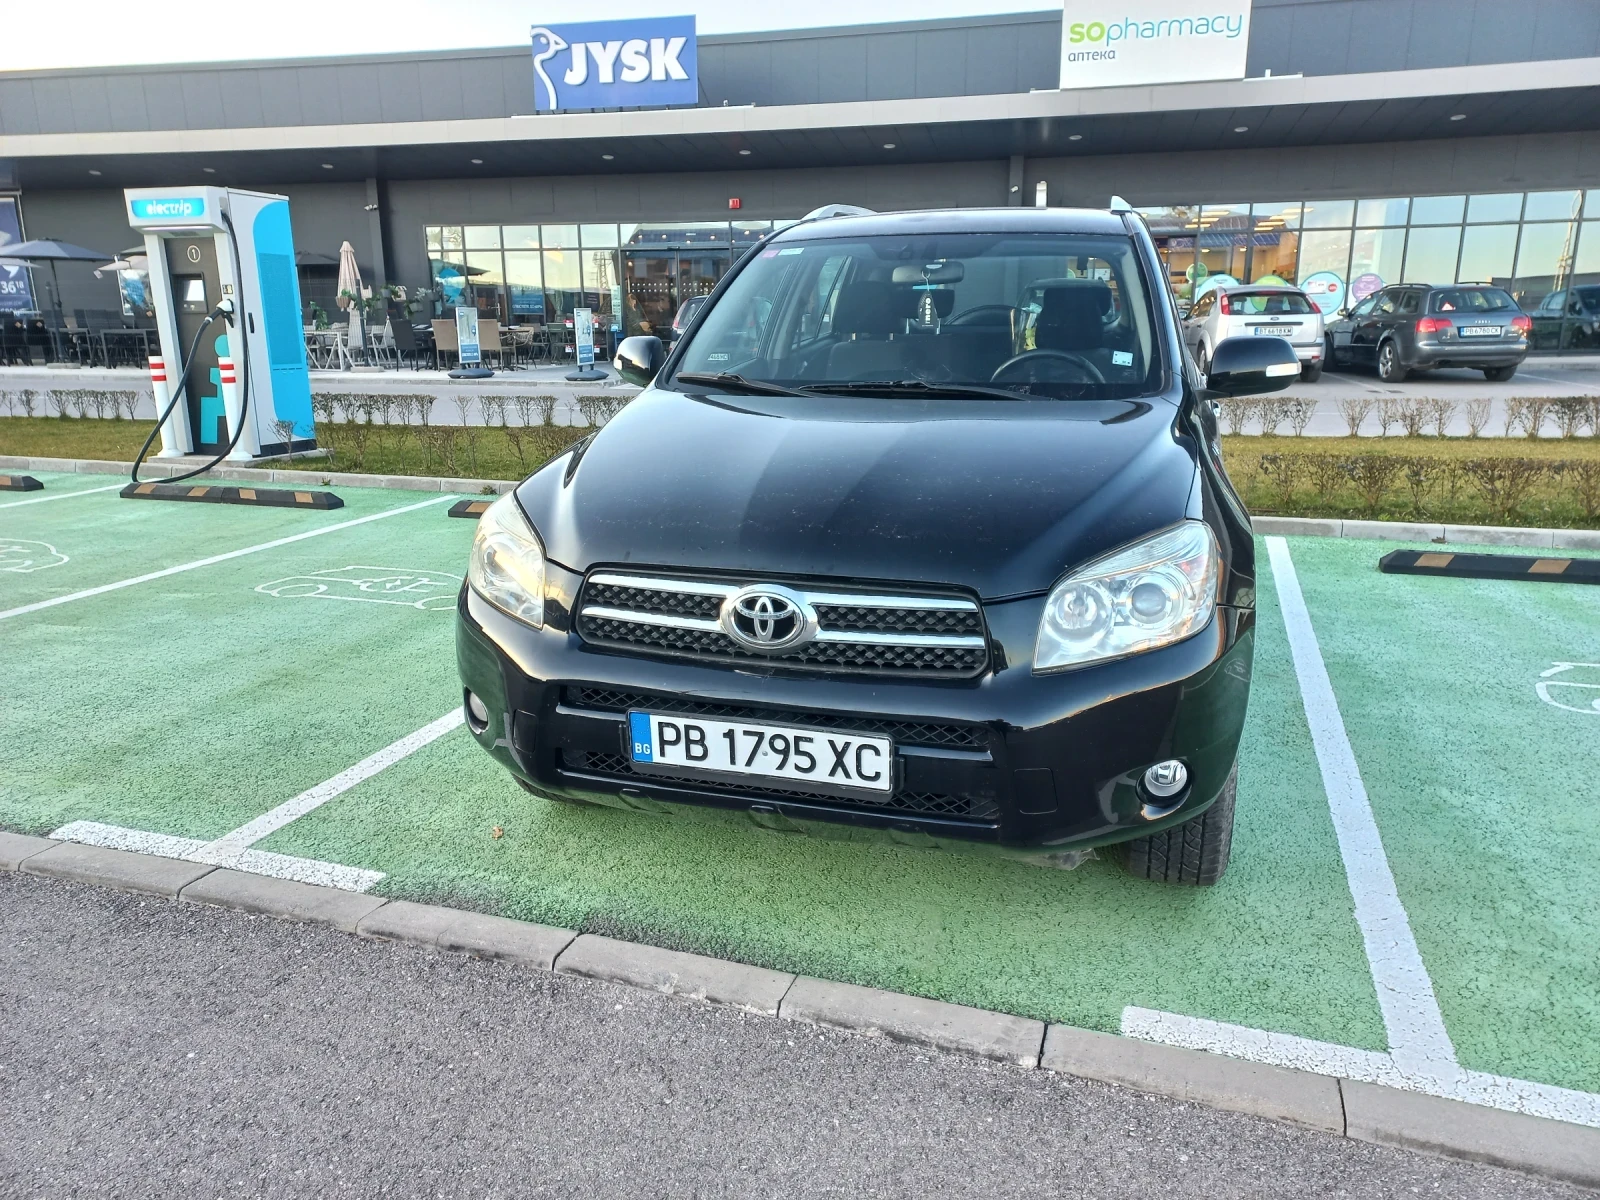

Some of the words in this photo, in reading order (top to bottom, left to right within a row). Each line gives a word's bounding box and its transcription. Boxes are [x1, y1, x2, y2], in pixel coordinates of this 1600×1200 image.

[1069, 14, 1243, 47] sopharmacy
[563, 37, 690, 86] JYSK
[1068, 50, 1116, 62] аптека
[146, 200, 192, 216] electrip
[1, 281, 16, 294] 36
[635, 742, 650, 755] BG
[657, 721, 709, 762] PB
[722, 728, 817, 774] 1795
[827, 739, 882, 783] XC
